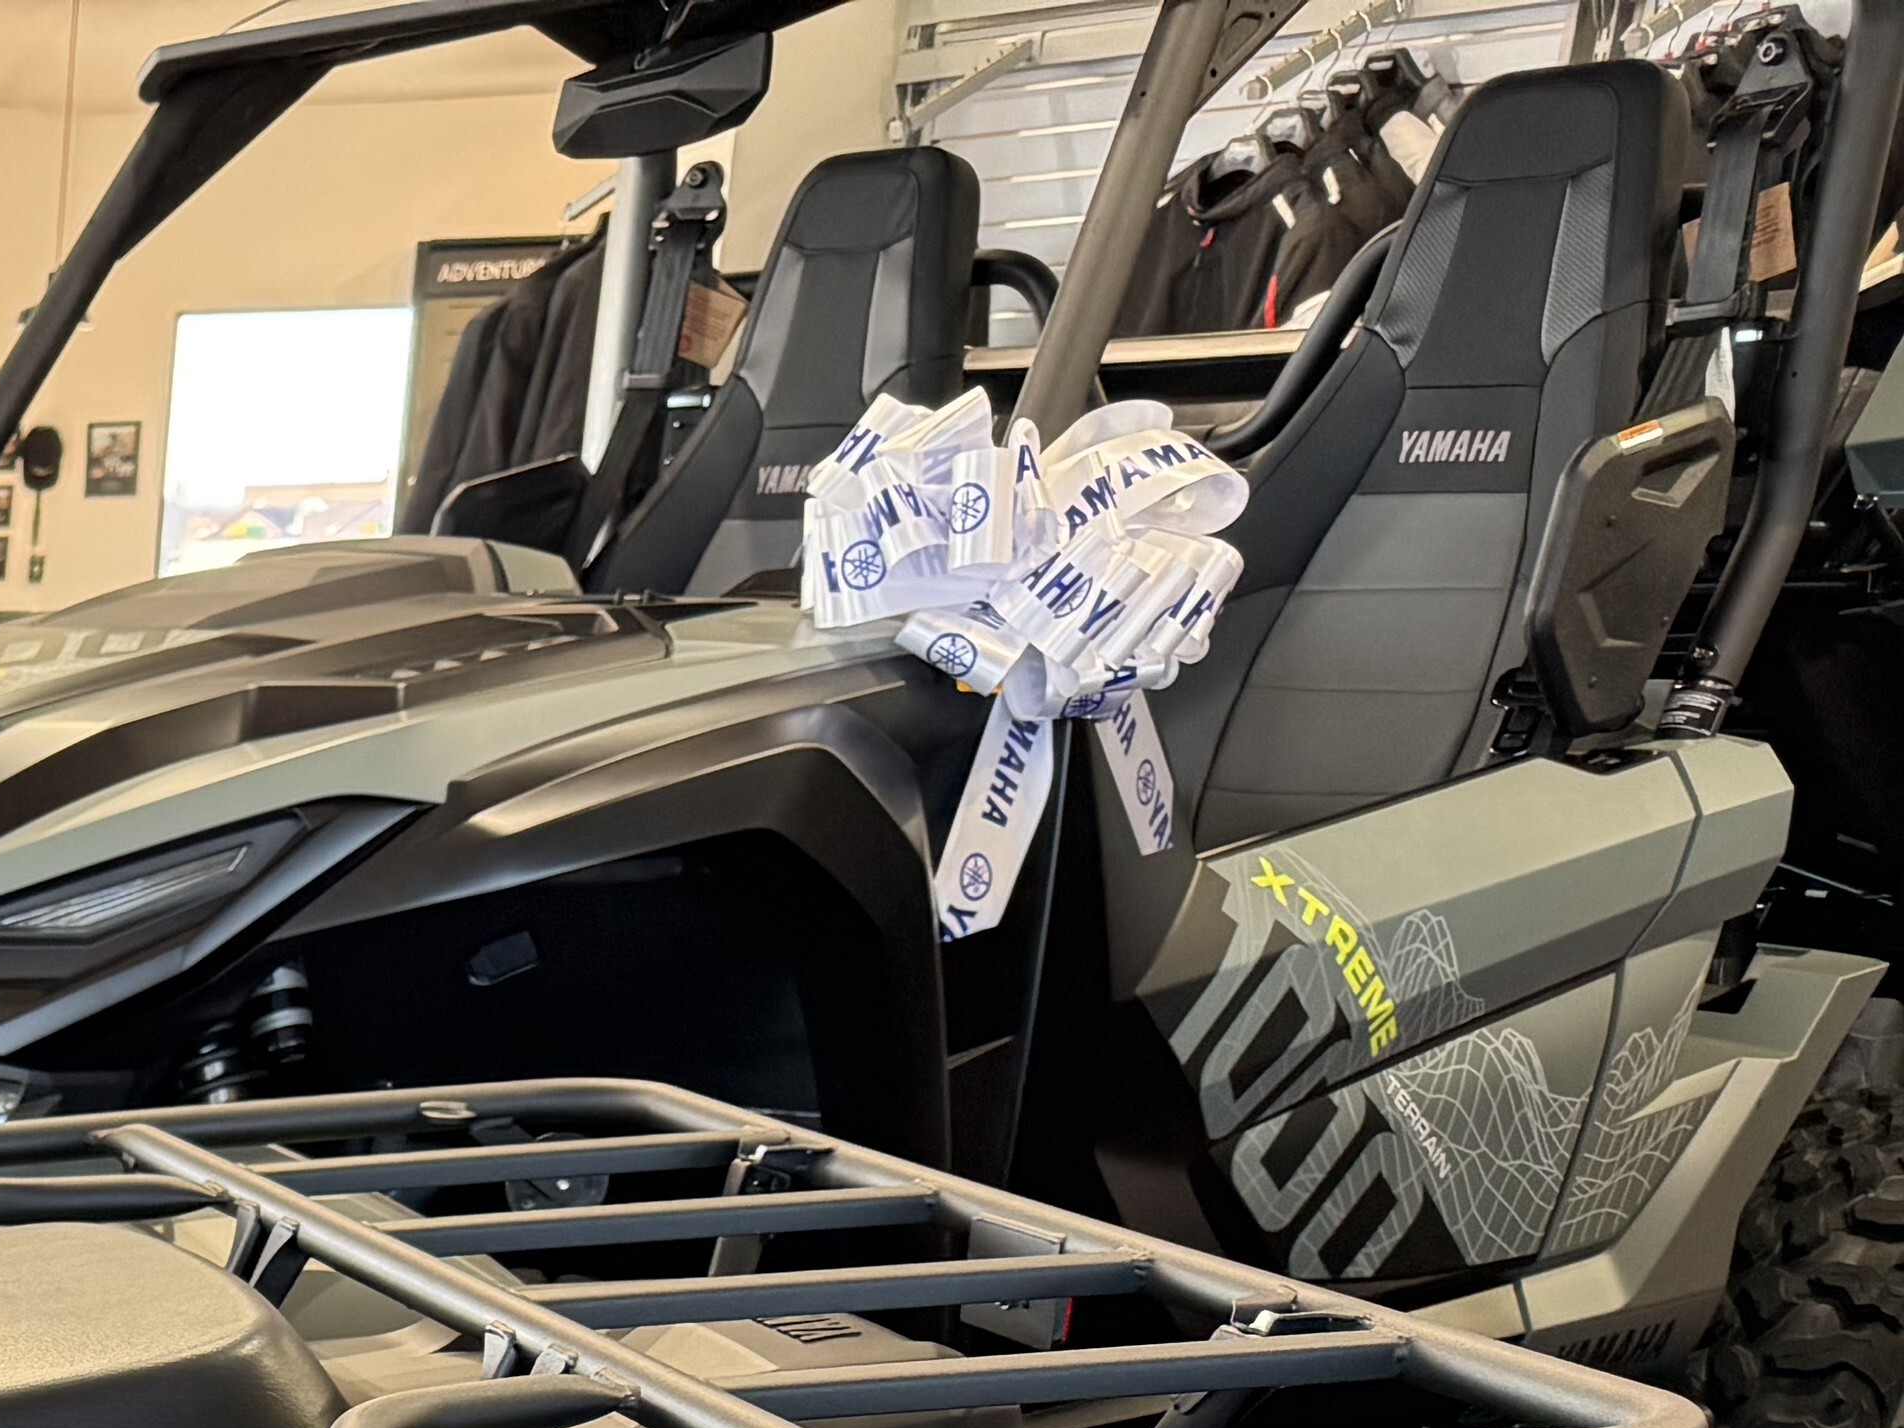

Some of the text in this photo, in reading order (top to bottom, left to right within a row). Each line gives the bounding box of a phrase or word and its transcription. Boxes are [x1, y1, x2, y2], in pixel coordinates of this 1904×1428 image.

[1398, 430, 1511, 464] YAMAHA
[1249, 856, 1398, 1058] XTREME
[1385, 1072, 1455, 1180] TERRAIN
